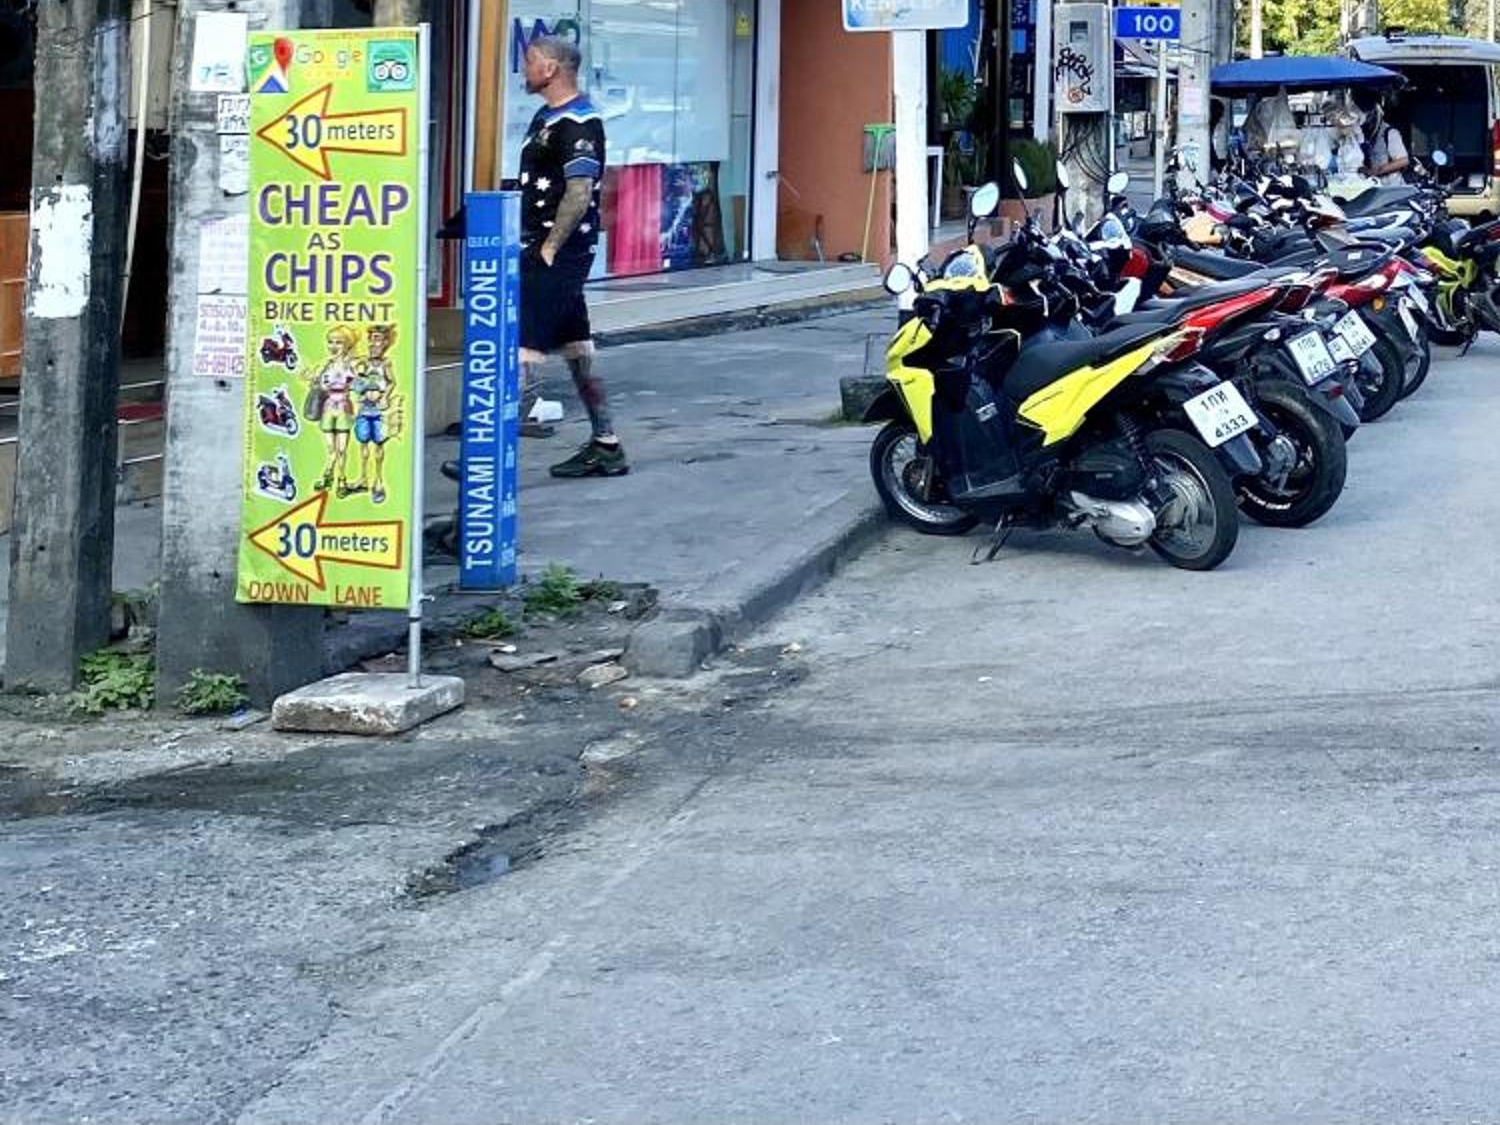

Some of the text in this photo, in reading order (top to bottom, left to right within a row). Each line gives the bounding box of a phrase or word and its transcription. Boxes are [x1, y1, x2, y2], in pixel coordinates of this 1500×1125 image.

[1134, 14, 1174, 33] 100
[285, 114, 396, 150] 30 meters
[258, 183, 410, 226] CHEAP
[307, 232, 341, 251] AS
[264, 252, 394, 296] CHIPS
[265, 300, 395, 322] BIKE RENT
[470, 258, 498, 328] ZONE
[468, 340, 497, 444] HAZARD
[465, 456, 494, 570] TSUNAMI
[277, 522, 390, 559] 30 meters
[248, 580, 383, 606] DOWN LANE
